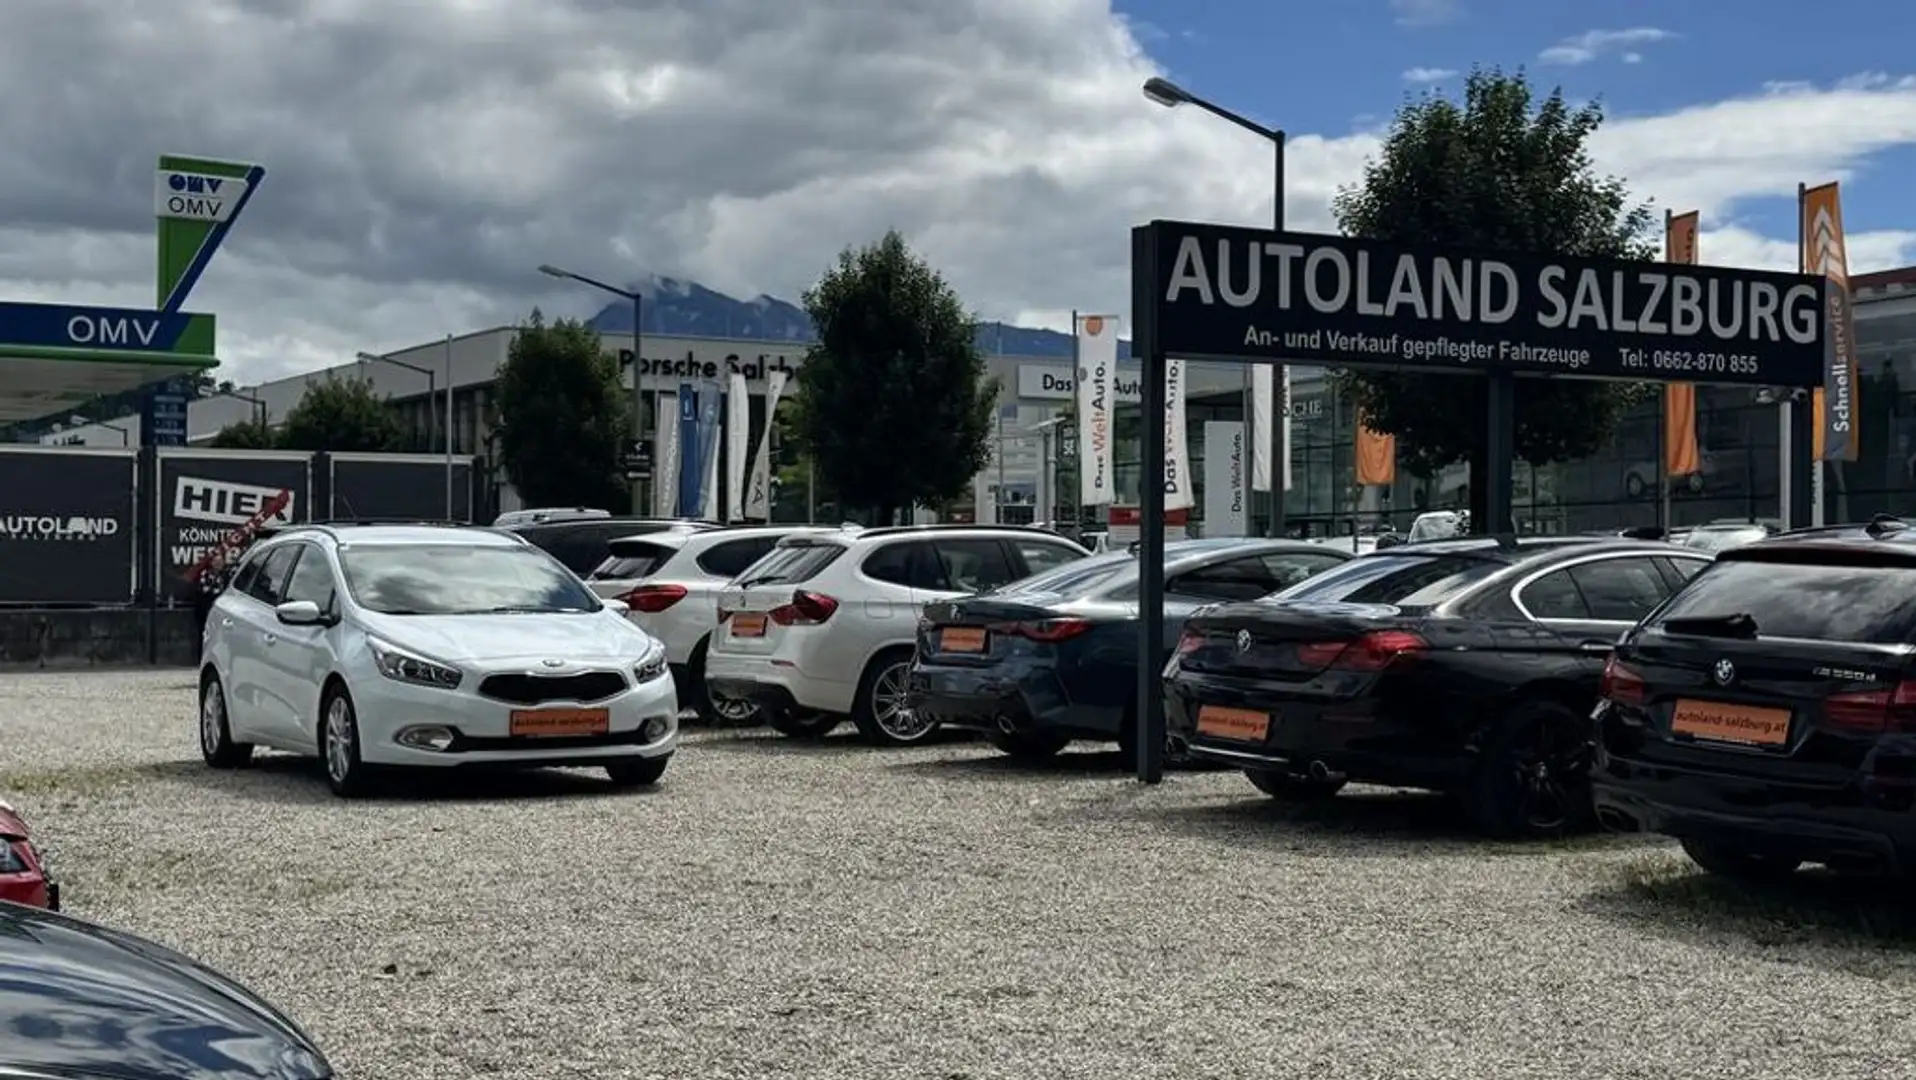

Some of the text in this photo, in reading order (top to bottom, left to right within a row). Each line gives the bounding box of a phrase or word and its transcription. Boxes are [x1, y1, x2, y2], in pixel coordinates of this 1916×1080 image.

[168, 196, 222, 217] OMV
[1165, 235, 1818, 345] AUTOLAND SALZBURG
[67, 315, 160, 346] OMV
[1244, 324, 1759, 374] An- und Verkauf gepflegter Fahrzeuge Tel: 0662-870 855
[619, 350, 718, 378] Porsche
[1043, 374, 1072, 392] Das
[1164, 458, 1178, 494] Das
[1231, 489, 1242, 513] Das
